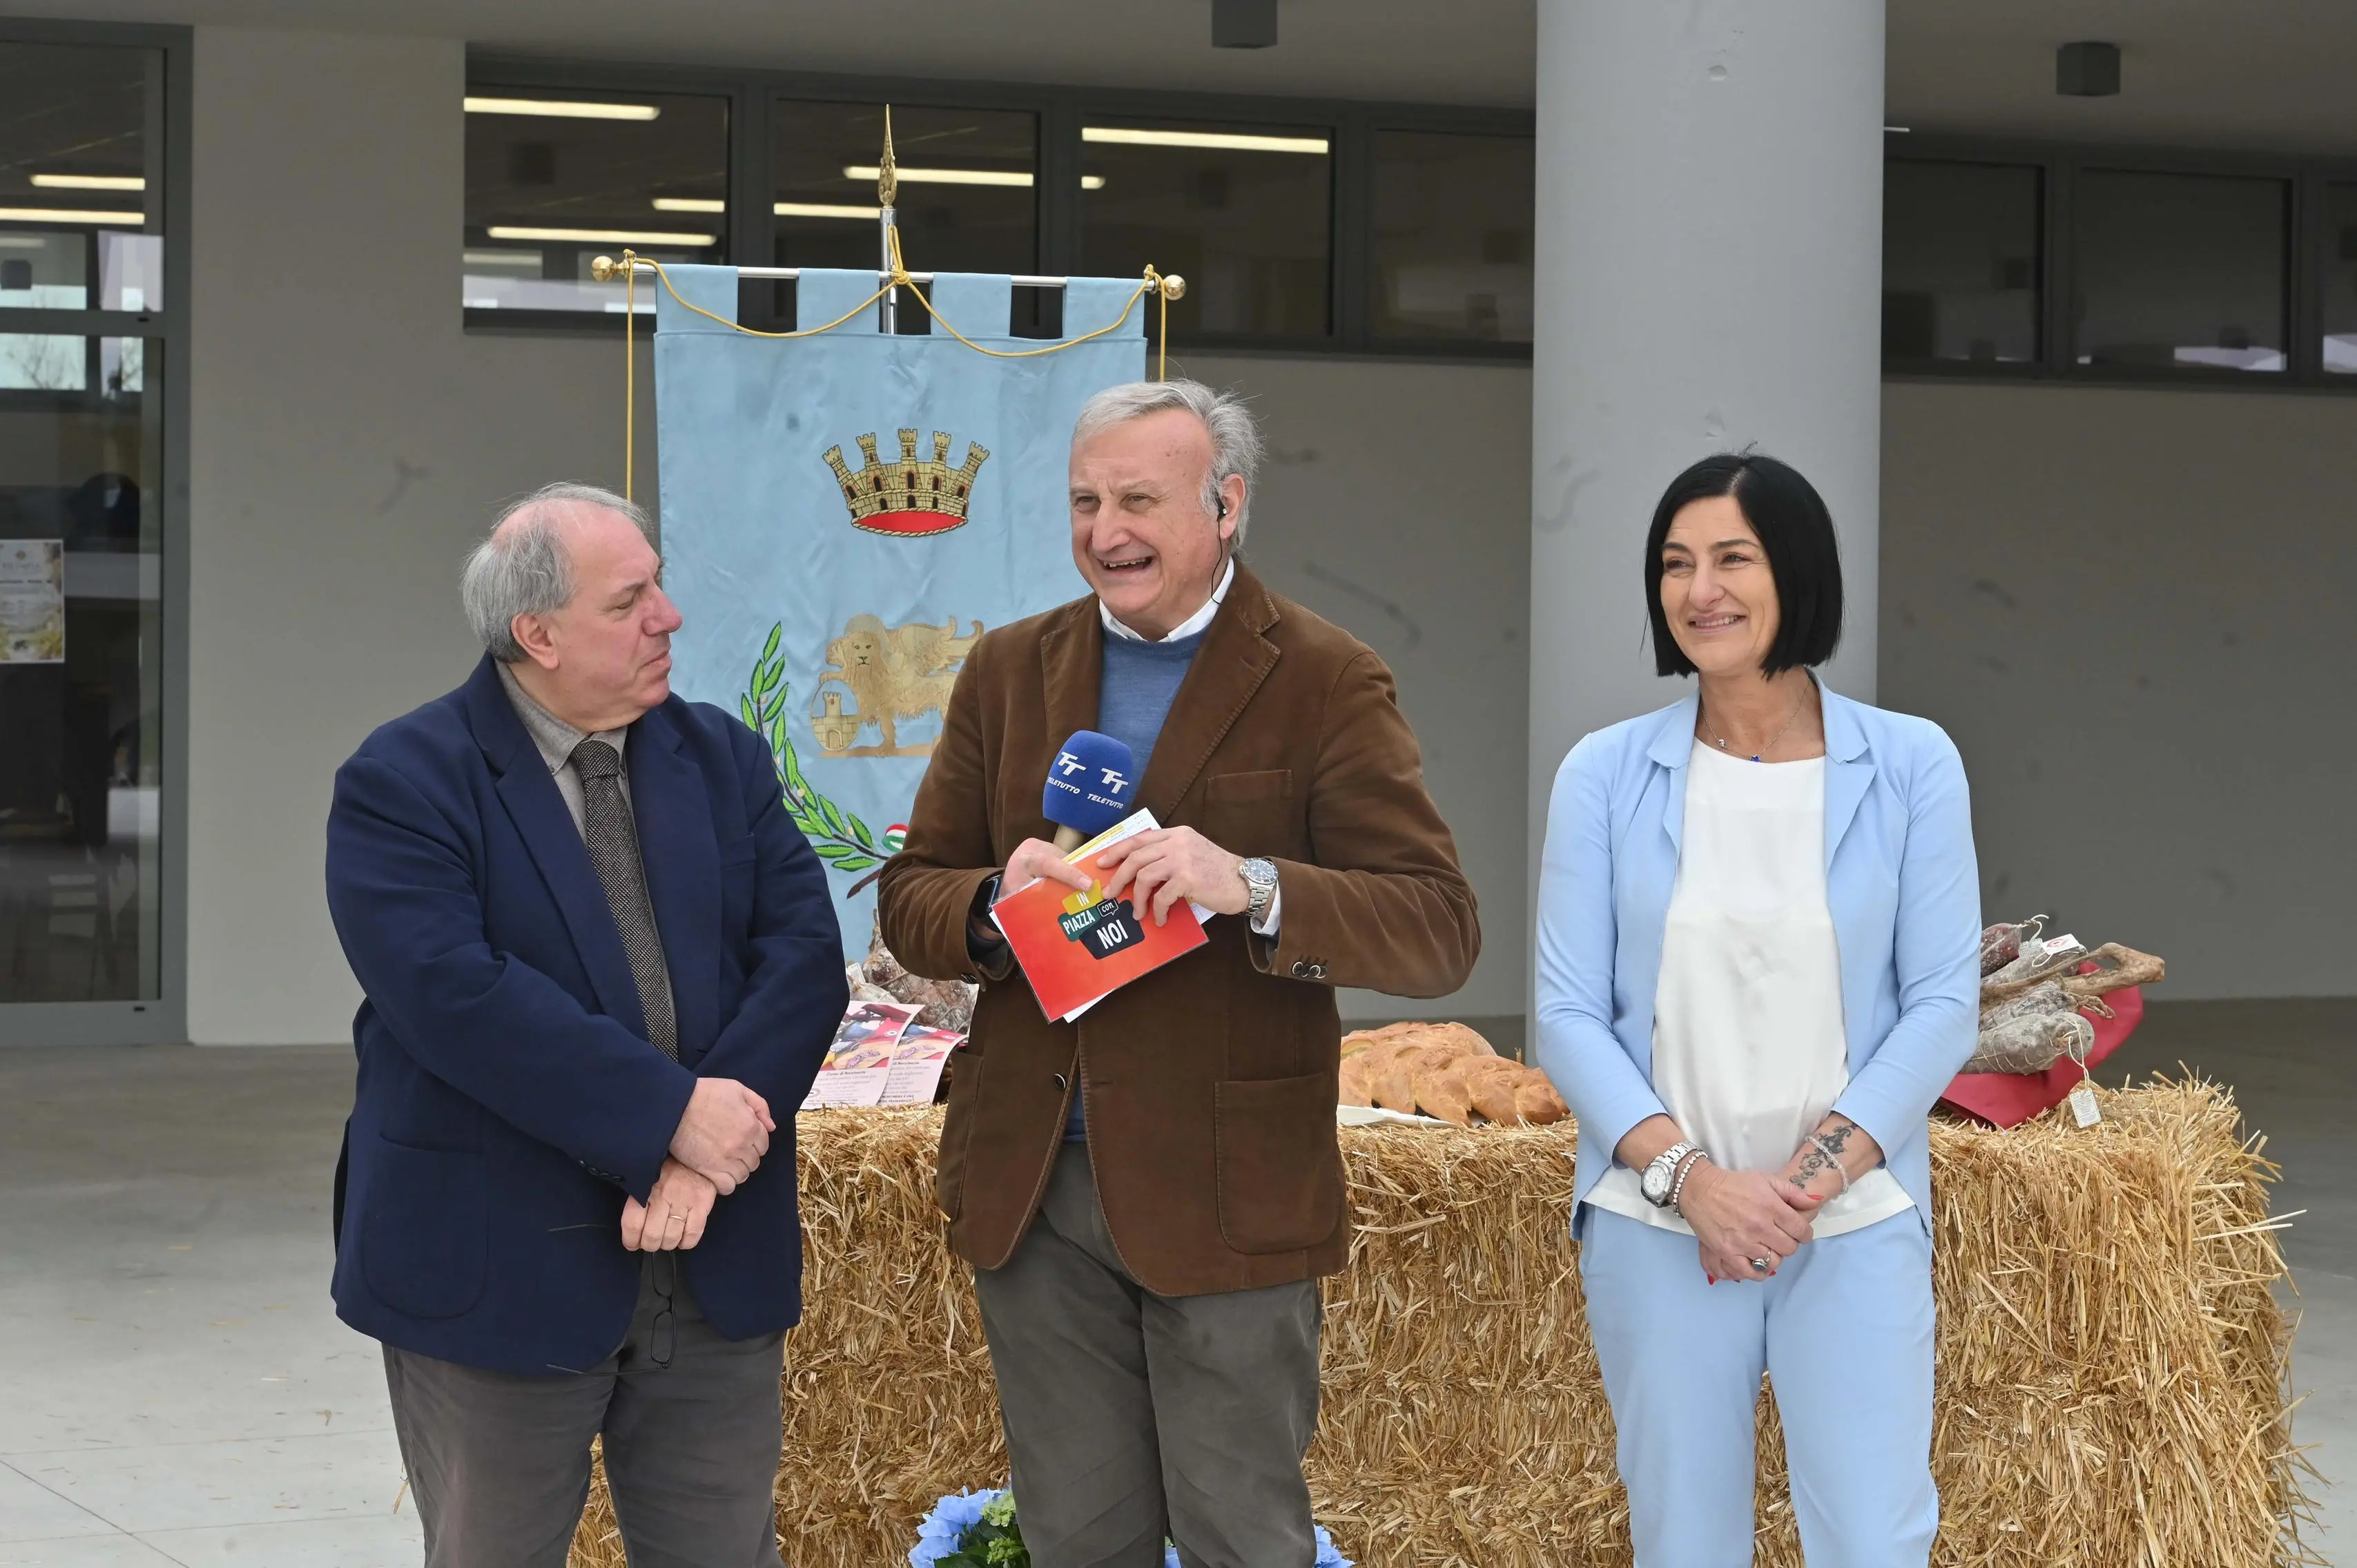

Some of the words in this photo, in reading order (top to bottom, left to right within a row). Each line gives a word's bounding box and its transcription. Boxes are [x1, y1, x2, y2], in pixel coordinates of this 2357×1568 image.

[1047, 777, 1080, 794] TELETUTTO
[1087, 793, 1124, 809] TELETUTTO
[1076, 891, 1090, 907] IN
[1101, 902, 1114, 913] con
[1063, 909, 1096, 935] PIAZZA
[1096, 918, 1129, 950] NOI
